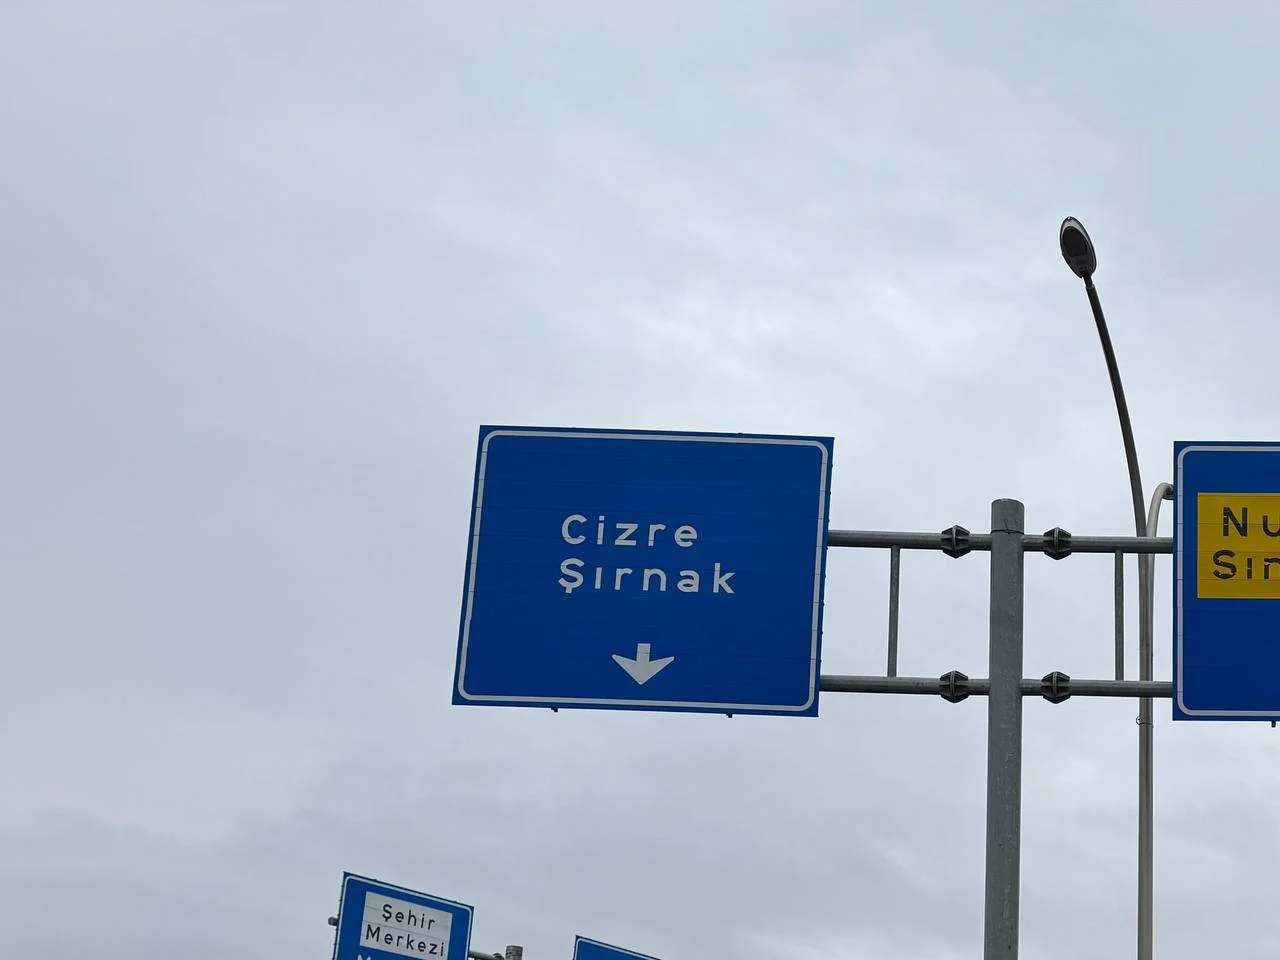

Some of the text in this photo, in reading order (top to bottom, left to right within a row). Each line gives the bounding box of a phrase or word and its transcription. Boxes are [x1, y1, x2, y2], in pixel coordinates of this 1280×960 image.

[561, 514, 698, 547] Cizre
[558, 558, 735, 593] Şırnak
[381, 903, 435, 931] Şehir
[365, 924, 445, 957] Merkezi
